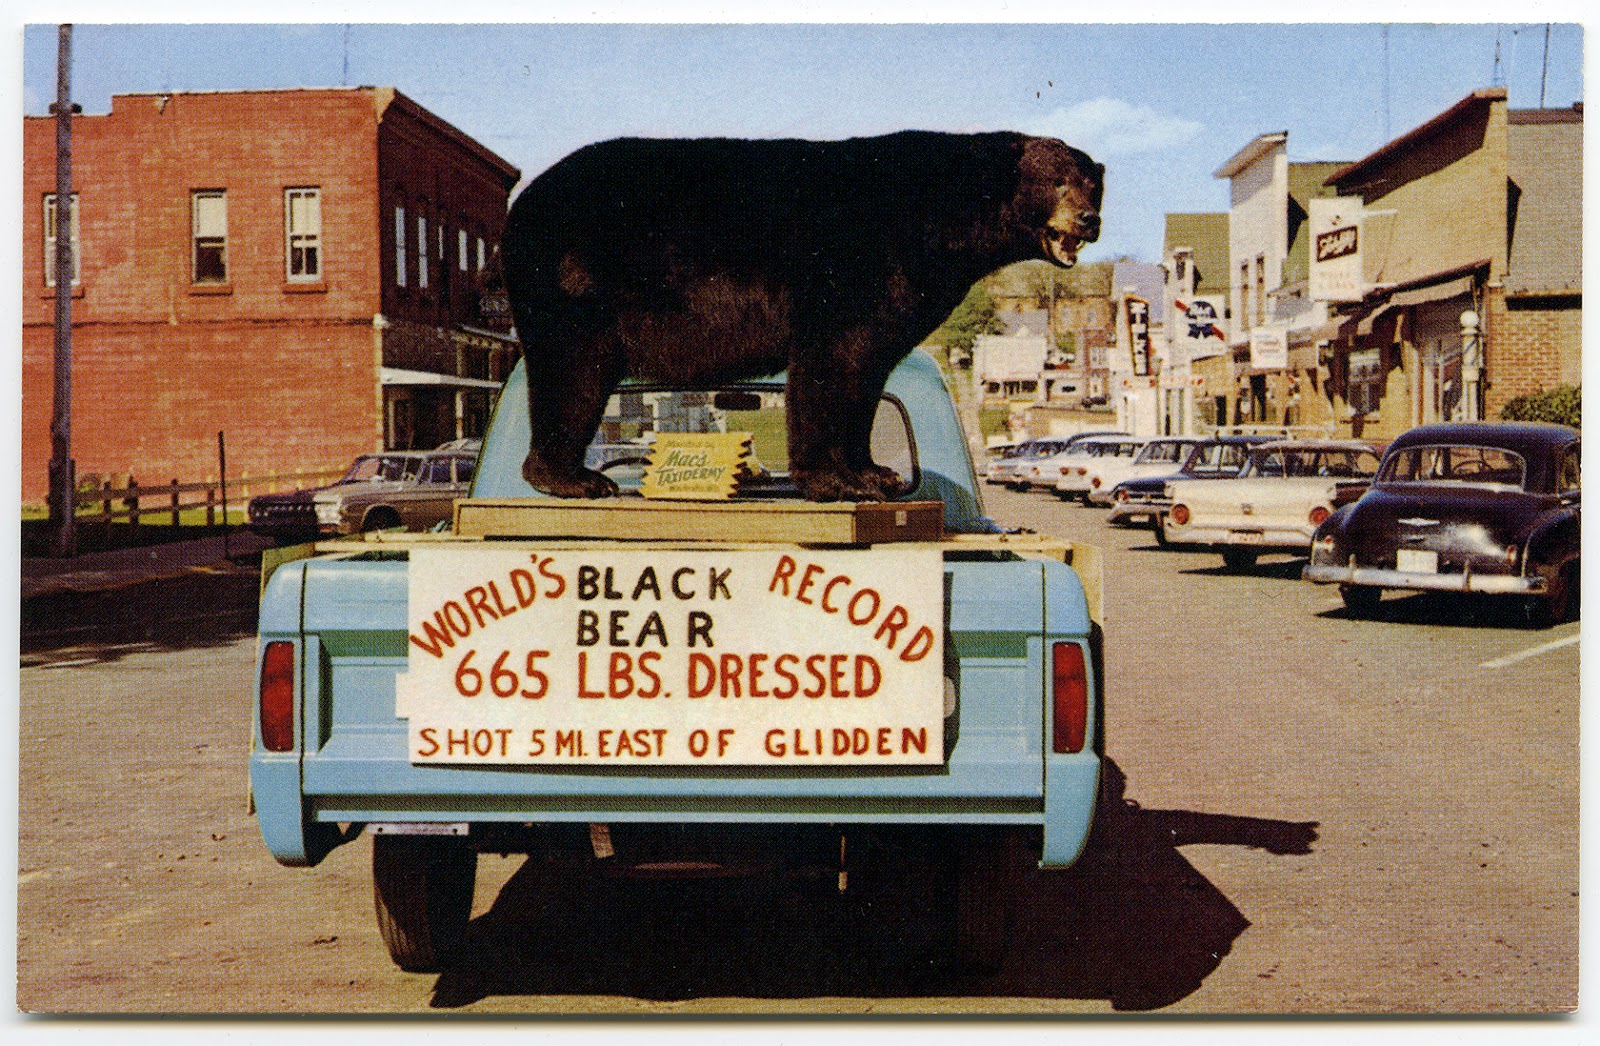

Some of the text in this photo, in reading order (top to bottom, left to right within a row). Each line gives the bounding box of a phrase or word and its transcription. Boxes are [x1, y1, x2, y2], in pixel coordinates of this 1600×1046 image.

[656, 466, 726, 486] TAXIDERMY
[411, 554, 933, 661] WORLD'S BLACK RECORD
[577, 610, 713, 647] BEAR
[456, 650, 881, 699] 665 LBS. DRESSED
[419, 728, 926, 757] SHOT 5 MI. EAST OF GLIDDEN
